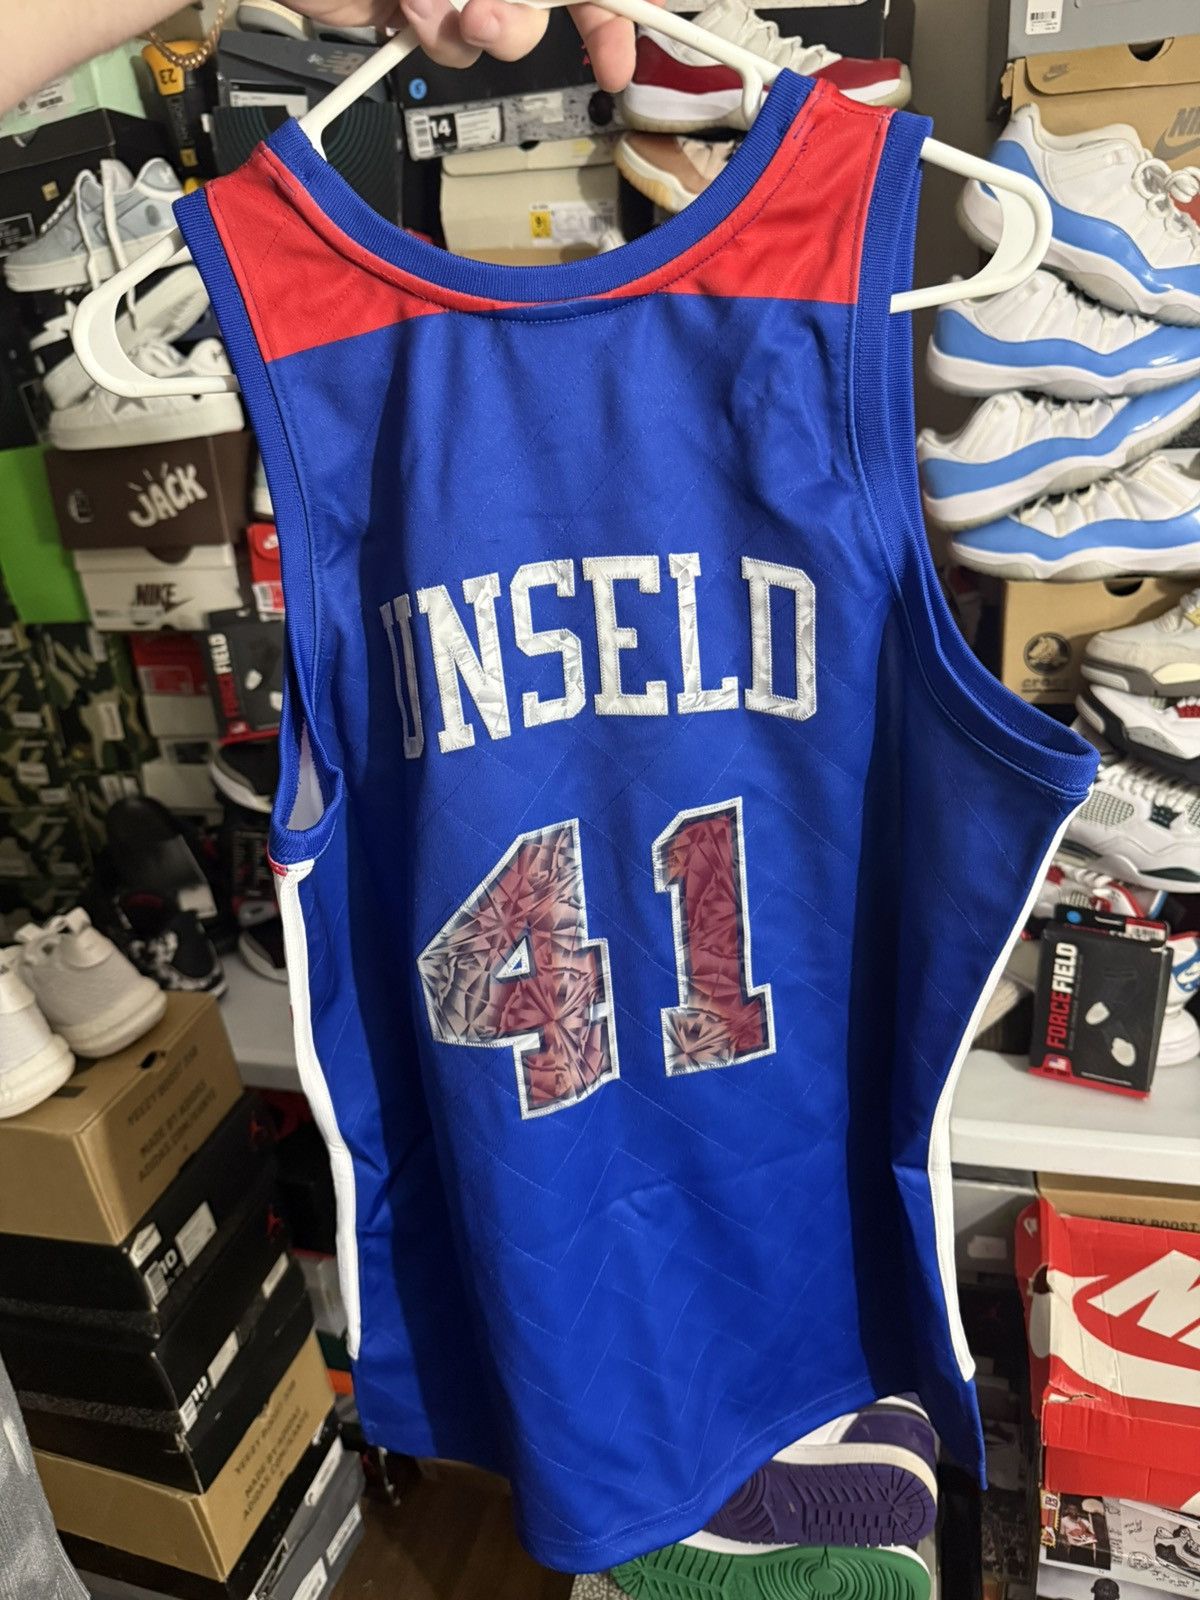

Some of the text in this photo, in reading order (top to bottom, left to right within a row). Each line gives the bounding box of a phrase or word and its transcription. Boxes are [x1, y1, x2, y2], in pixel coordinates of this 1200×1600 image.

[430, 119, 452, 139] 14
[1167, 106, 1200, 137] NI
[128, 463, 208, 528] JACK
[380, 552, 817, 760] UNSELD
[416, 796, 777, 1121] 41
[160, 1249, 178, 1274] 10
